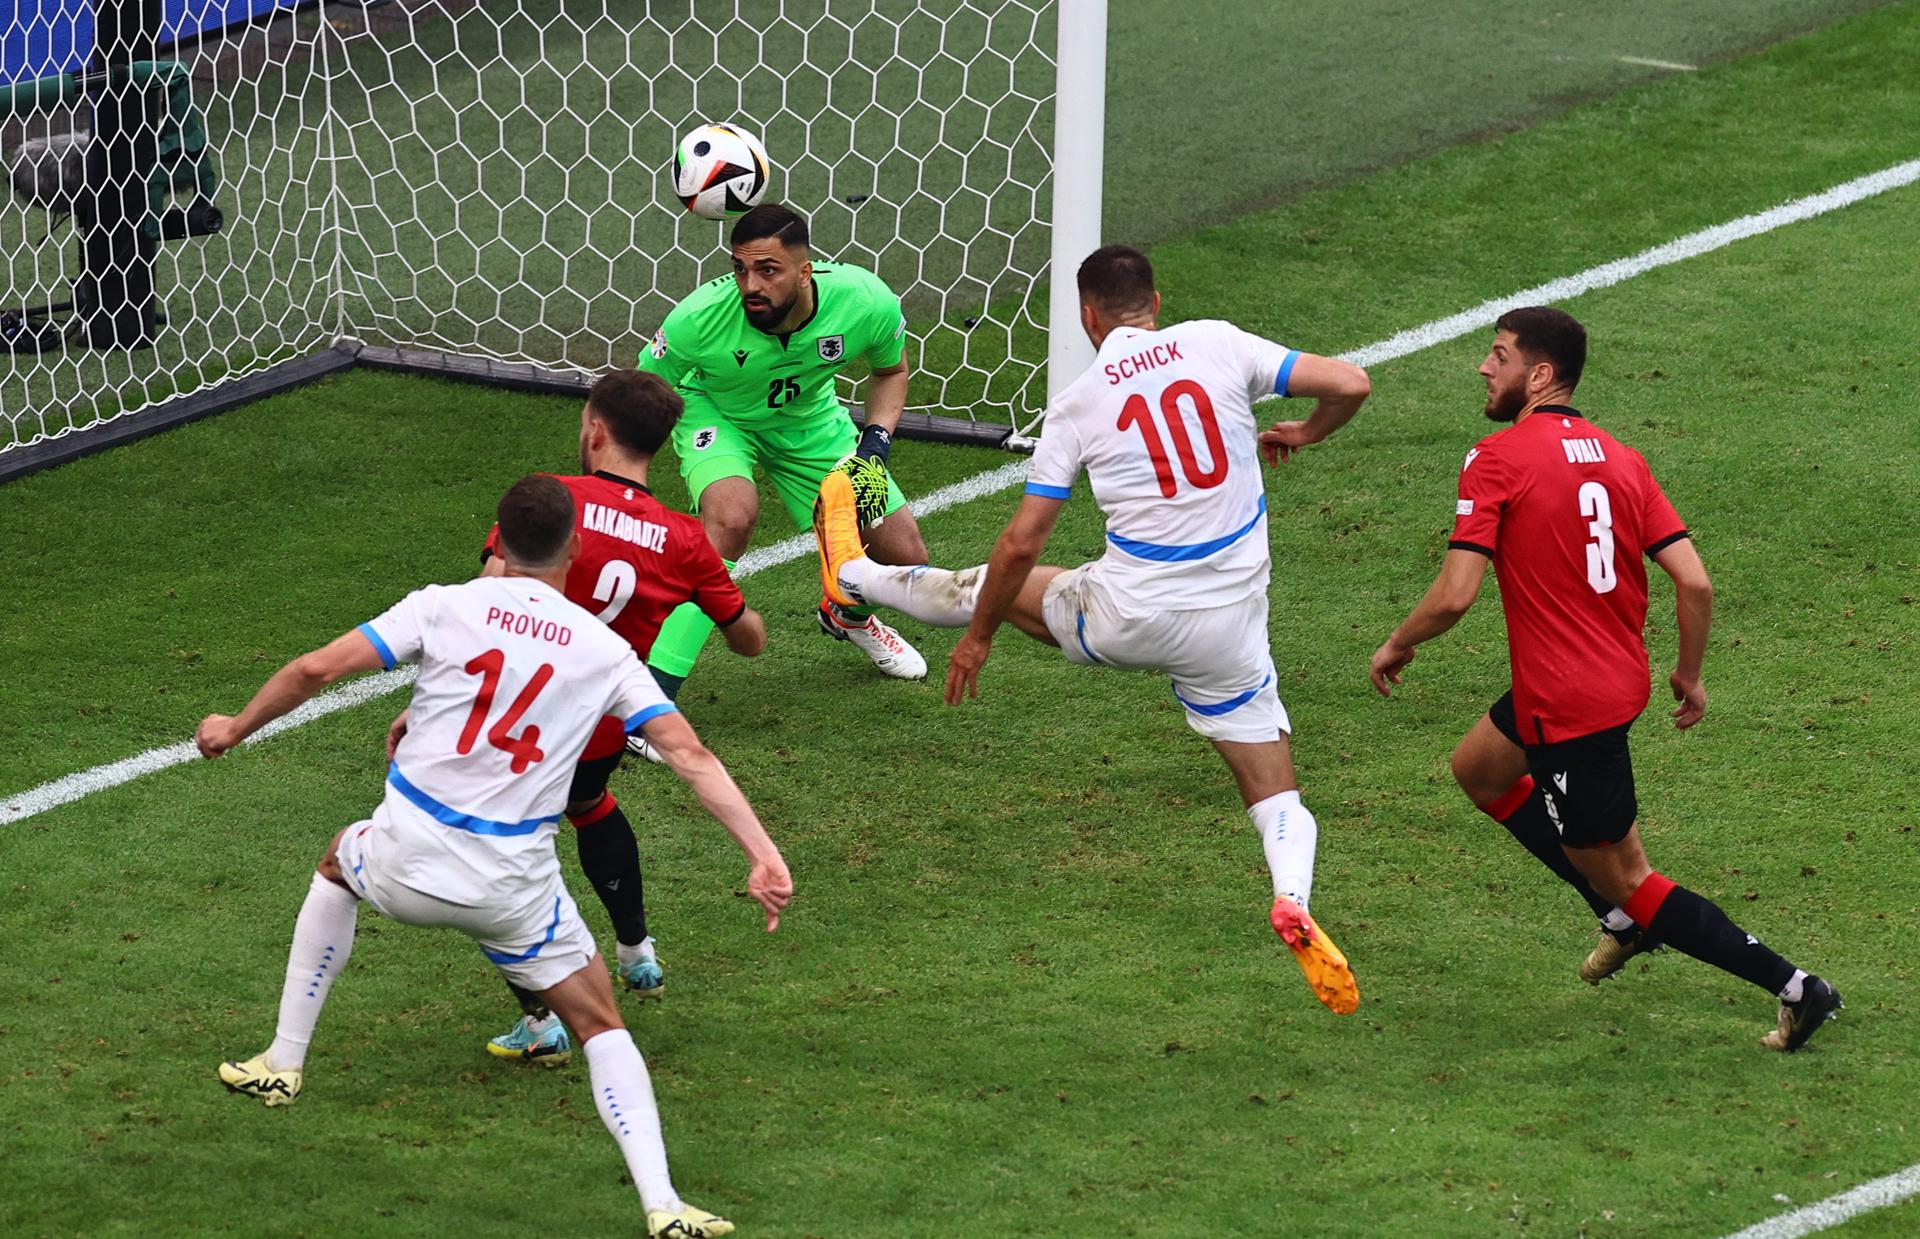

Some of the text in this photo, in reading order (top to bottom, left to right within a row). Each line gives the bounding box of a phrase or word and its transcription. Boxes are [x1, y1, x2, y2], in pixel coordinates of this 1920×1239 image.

[1103, 341, 1184, 386] SCHICK
[767, 374, 801, 409] 25
[1116, 379, 1230, 499] 10
[1560, 438, 1607, 464] DVALI
[582, 502, 669, 554] KAKABADZE
[1578, 481, 1618, 595] 3
[591, 559, 638, 625] 2
[486, 606, 573, 647] PROVOD
[455, 648, 555, 775] 14
